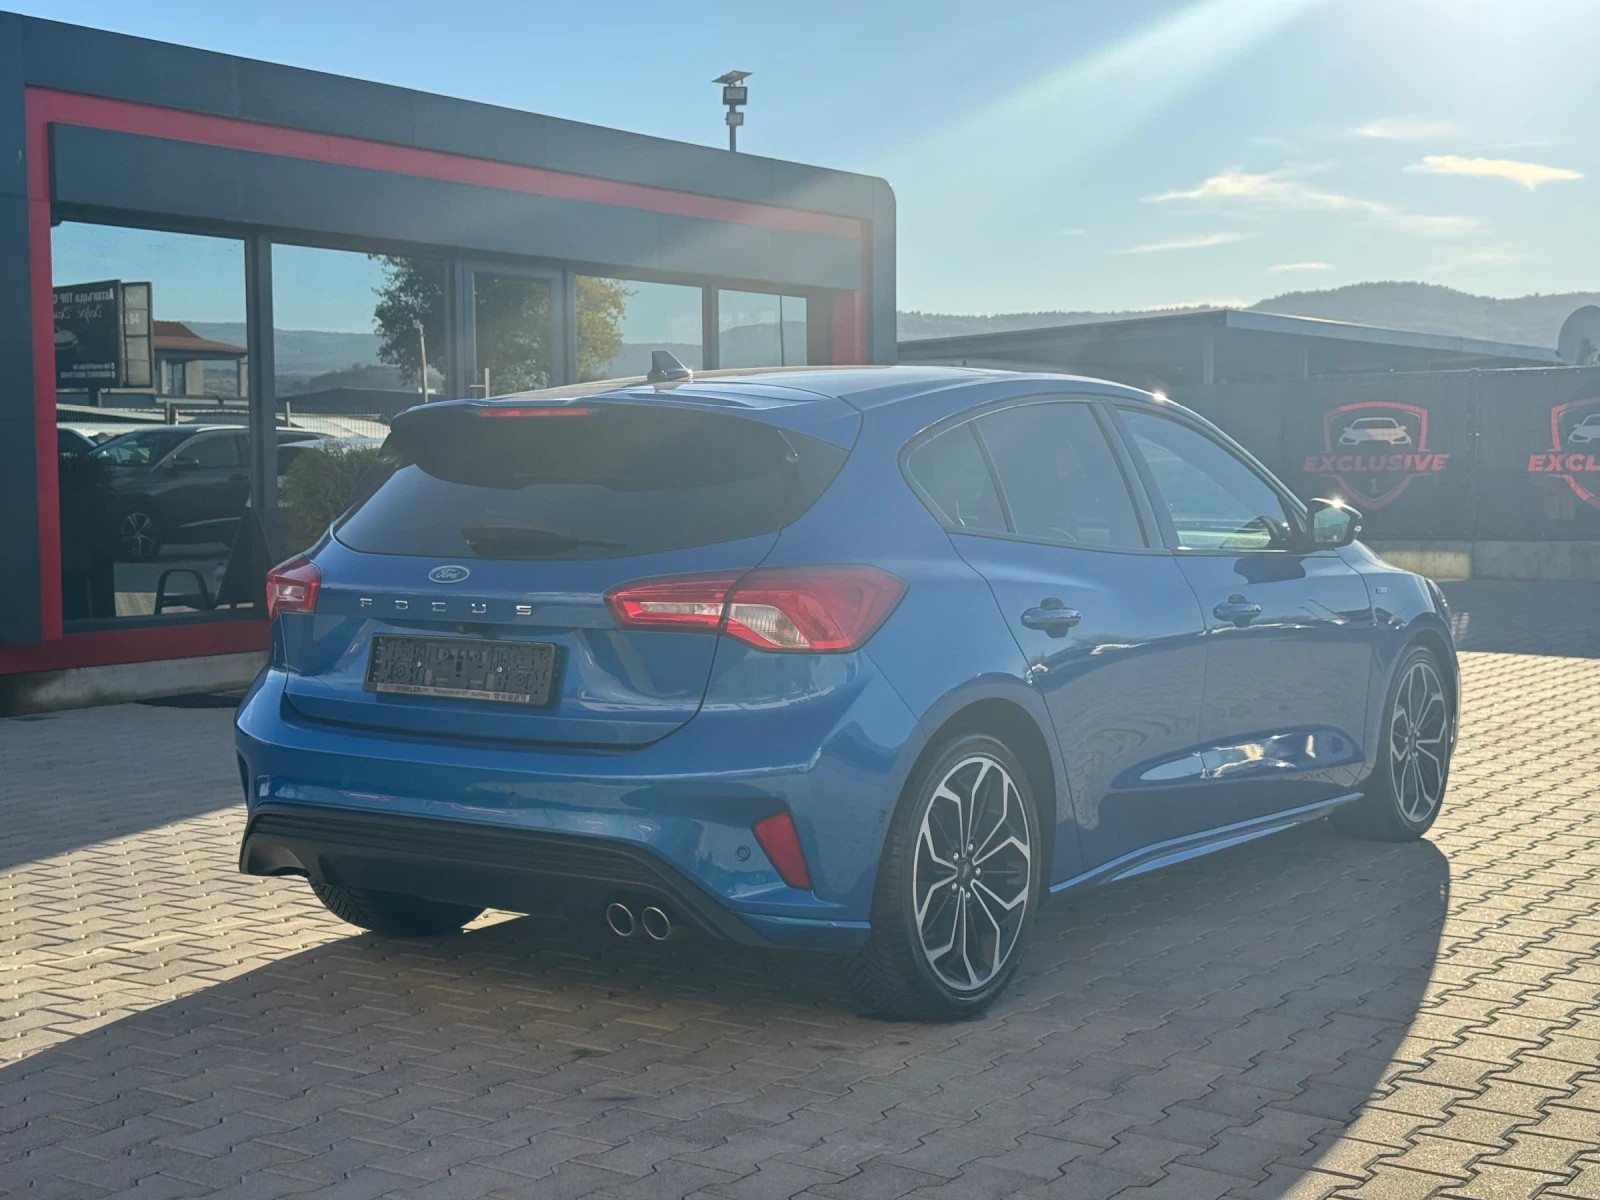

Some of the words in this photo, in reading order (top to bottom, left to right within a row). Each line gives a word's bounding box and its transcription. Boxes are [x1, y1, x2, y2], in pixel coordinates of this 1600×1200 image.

[1303, 454, 1450, 472] EXCLUSIVE
[435, 568, 461, 579] Ford
[359, 597, 532, 615] FOCUS
